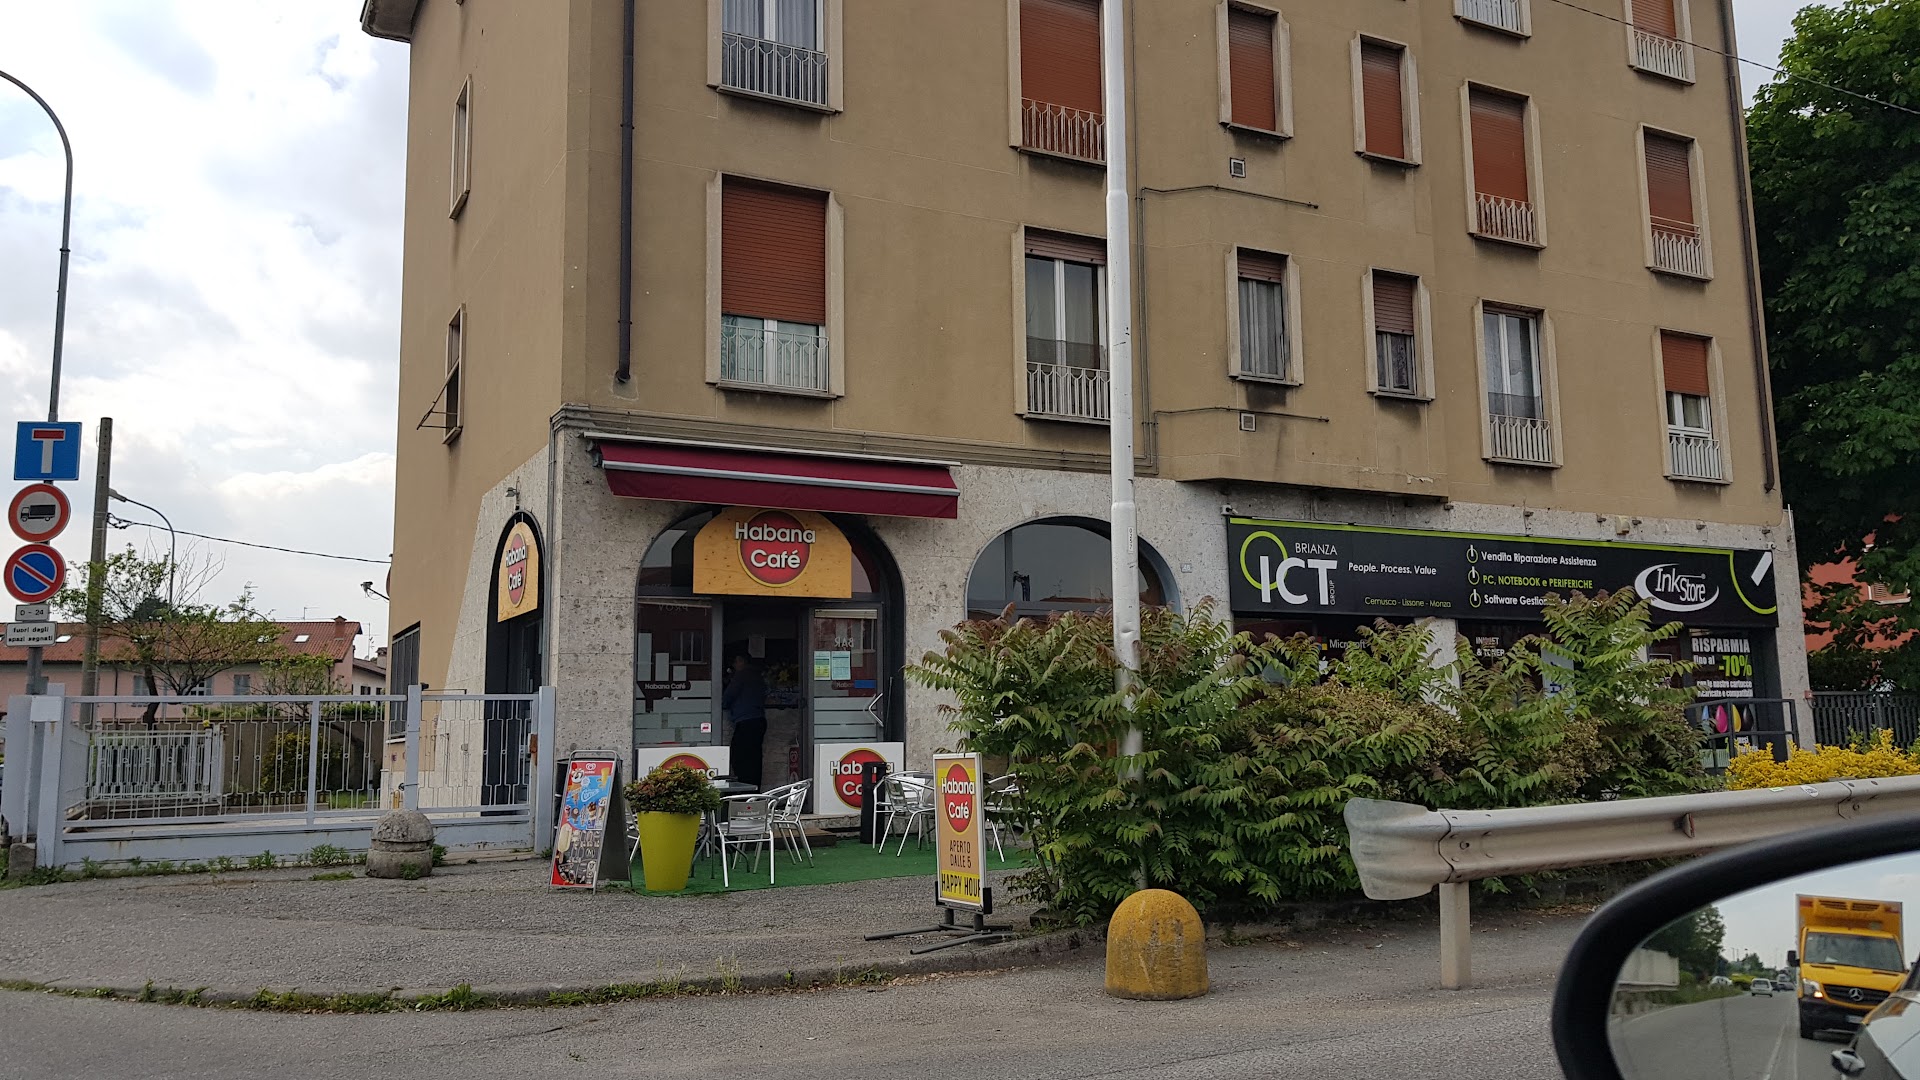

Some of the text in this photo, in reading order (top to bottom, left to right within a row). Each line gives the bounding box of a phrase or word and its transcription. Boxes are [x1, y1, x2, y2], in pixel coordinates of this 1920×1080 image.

[735, 521, 816, 543] Habana
[506, 545, 528, 567] Habana
[1295, 542, 1337, 555] BRIANZA
[750, 549, 800, 568] Café
[1481, 551, 1597, 566] Vendita Riparazione Assistenza
[1348, 562, 1437, 575] People. Process. Value
[508, 567, 523, 591] Café
[1259, 555, 1338, 606] ICT
[1483, 574, 1497, 586] PC,
[1498, 576, 1540, 587] NOTEBOOK
[1549, 578, 1593, 589] PERIFERICHE
[1655, 568, 1706, 602] Ink Store
[1402, 598, 1424, 607] Lissone
[1429, 600, 1452, 608] Monza
[1484, 594, 1518, 605] Software
[1691, 638, 1751, 653] RISPARMIA
[1719, 655, 1752, 677] -70%
[644, 682, 686, 690] Habana Café
[941, 777, 976, 795] Habana
[948, 801, 970, 820] Café
[950, 840, 971, 854] APERTO
[950, 853, 972, 869] DALLE 5
[941, 873, 963, 894] HAPPY
